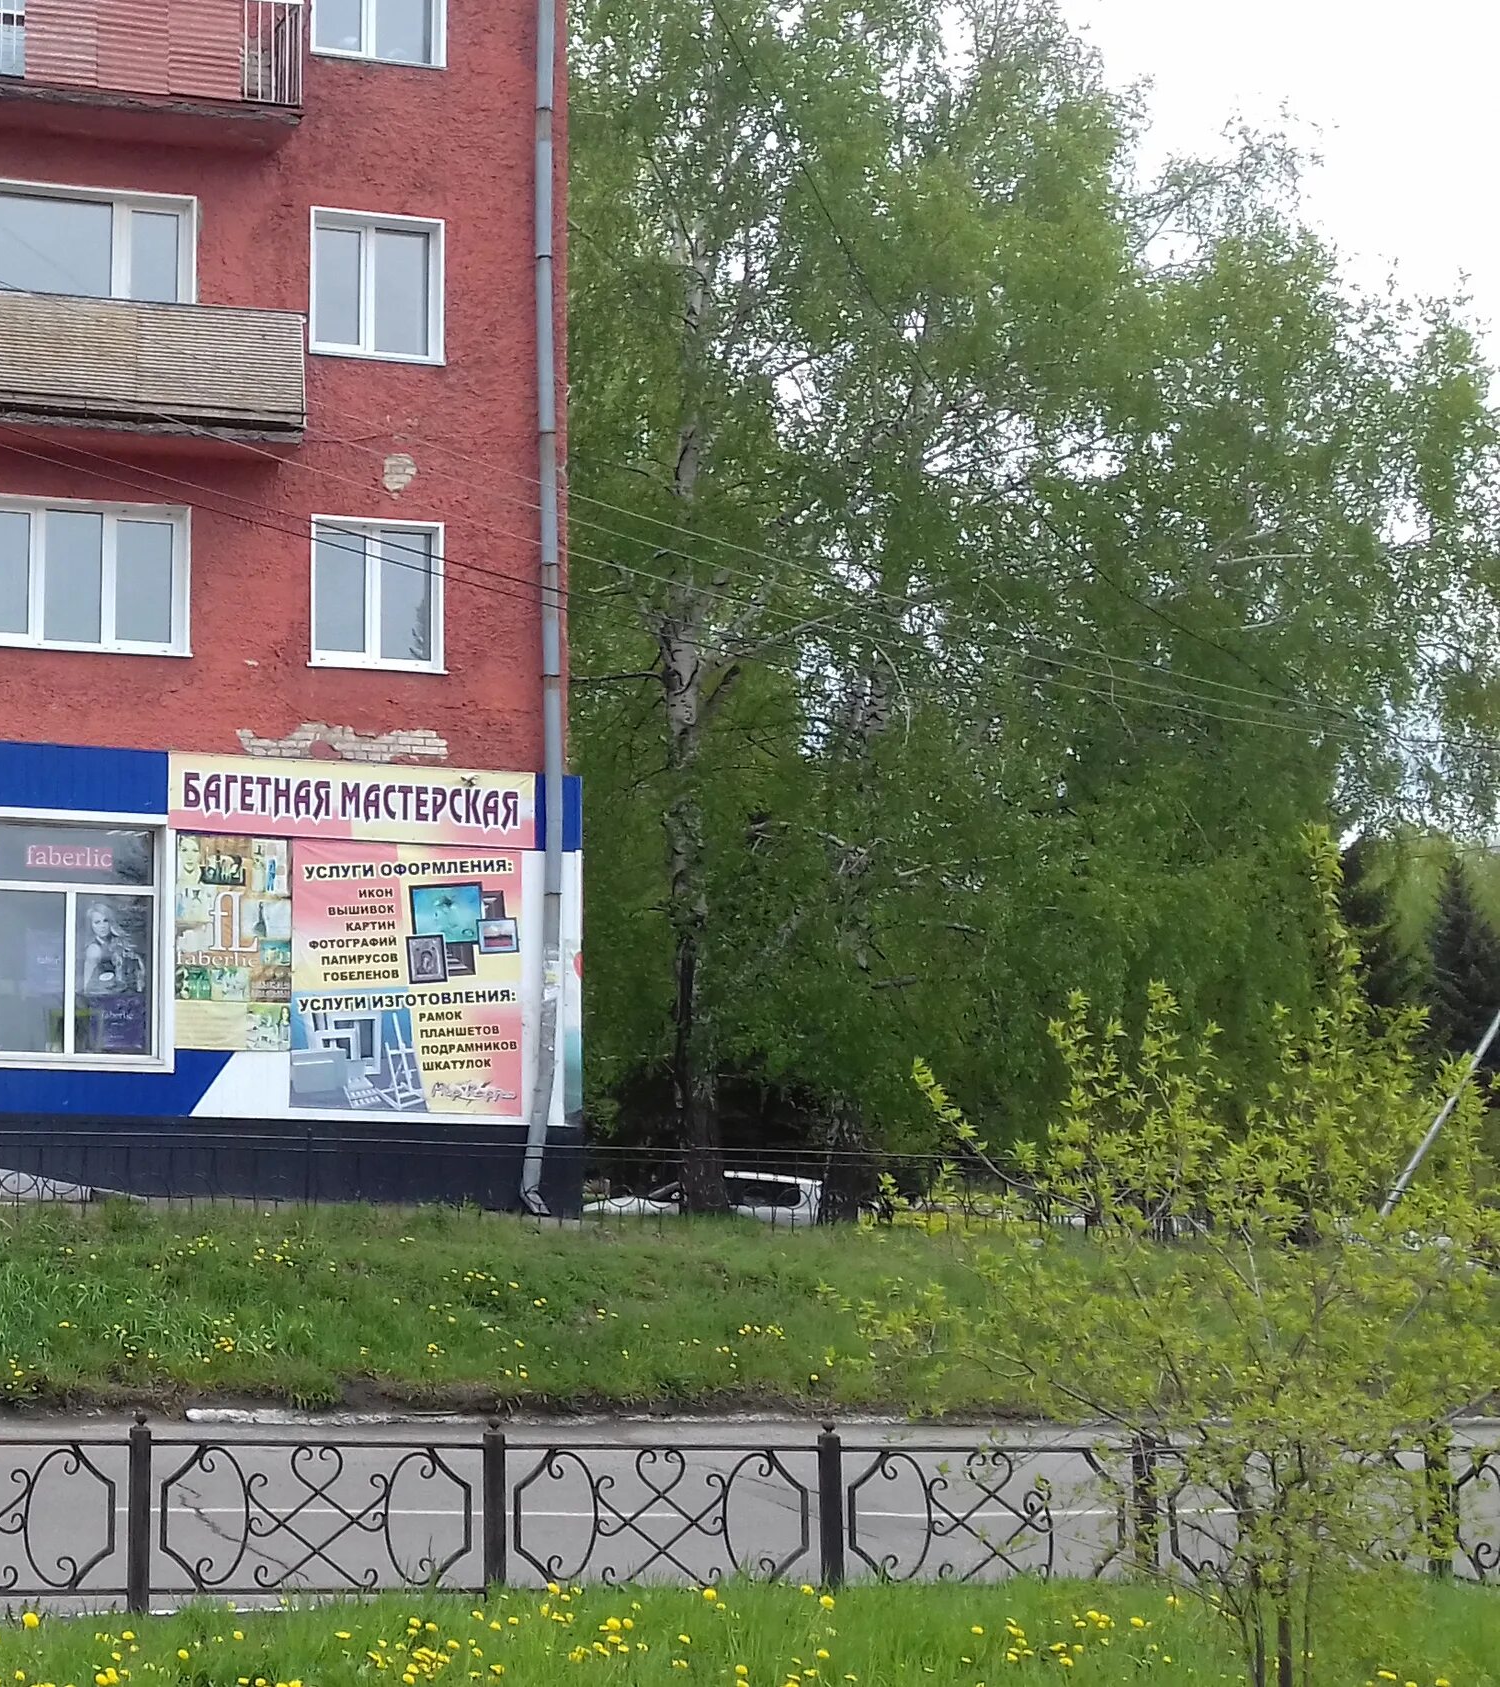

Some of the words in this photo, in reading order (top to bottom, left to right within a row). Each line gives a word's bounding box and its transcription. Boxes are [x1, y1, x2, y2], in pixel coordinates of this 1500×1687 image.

[183, 771, 332, 822] БАГЕТНАЯ
[340, 781, 520, 830] МАСТЕРСКАЯ
[26, 845, 113, 868] faberlic
[304, 863, 375, 881] УСЛУГИ
[380, 859, 513, 877] ОФОРМЛЕНИЯ:
[358, 887, 394, 898] ИКОН
[328, 904, 395, 917] ВЫШИВОК
[345, 921, 396, 932] КАРТИН
[308, 936, 398, 950] ФОТОГРАФИЙ
[176, 951, 258, 968] faberlic
[321, 953, 399, 966] ПАПИРУСОВ
[323, 969, 400, 982] ГОБЕЛЕНОВ
[298, 998, 366, 1012] УСЛУГИ
[371, 990, 517, 1009] ИЗГОТОВЛЕНИЯ:
[418, 1011, 463, 1022] РАМОК
[419, 1025, 500, 1038] ПЛАНШЕТОВ
[420, 1040, 518, 1055] ПОДРАМНИКОВ
[422, 1058, 492, 1072] ШКАТУЛОК
